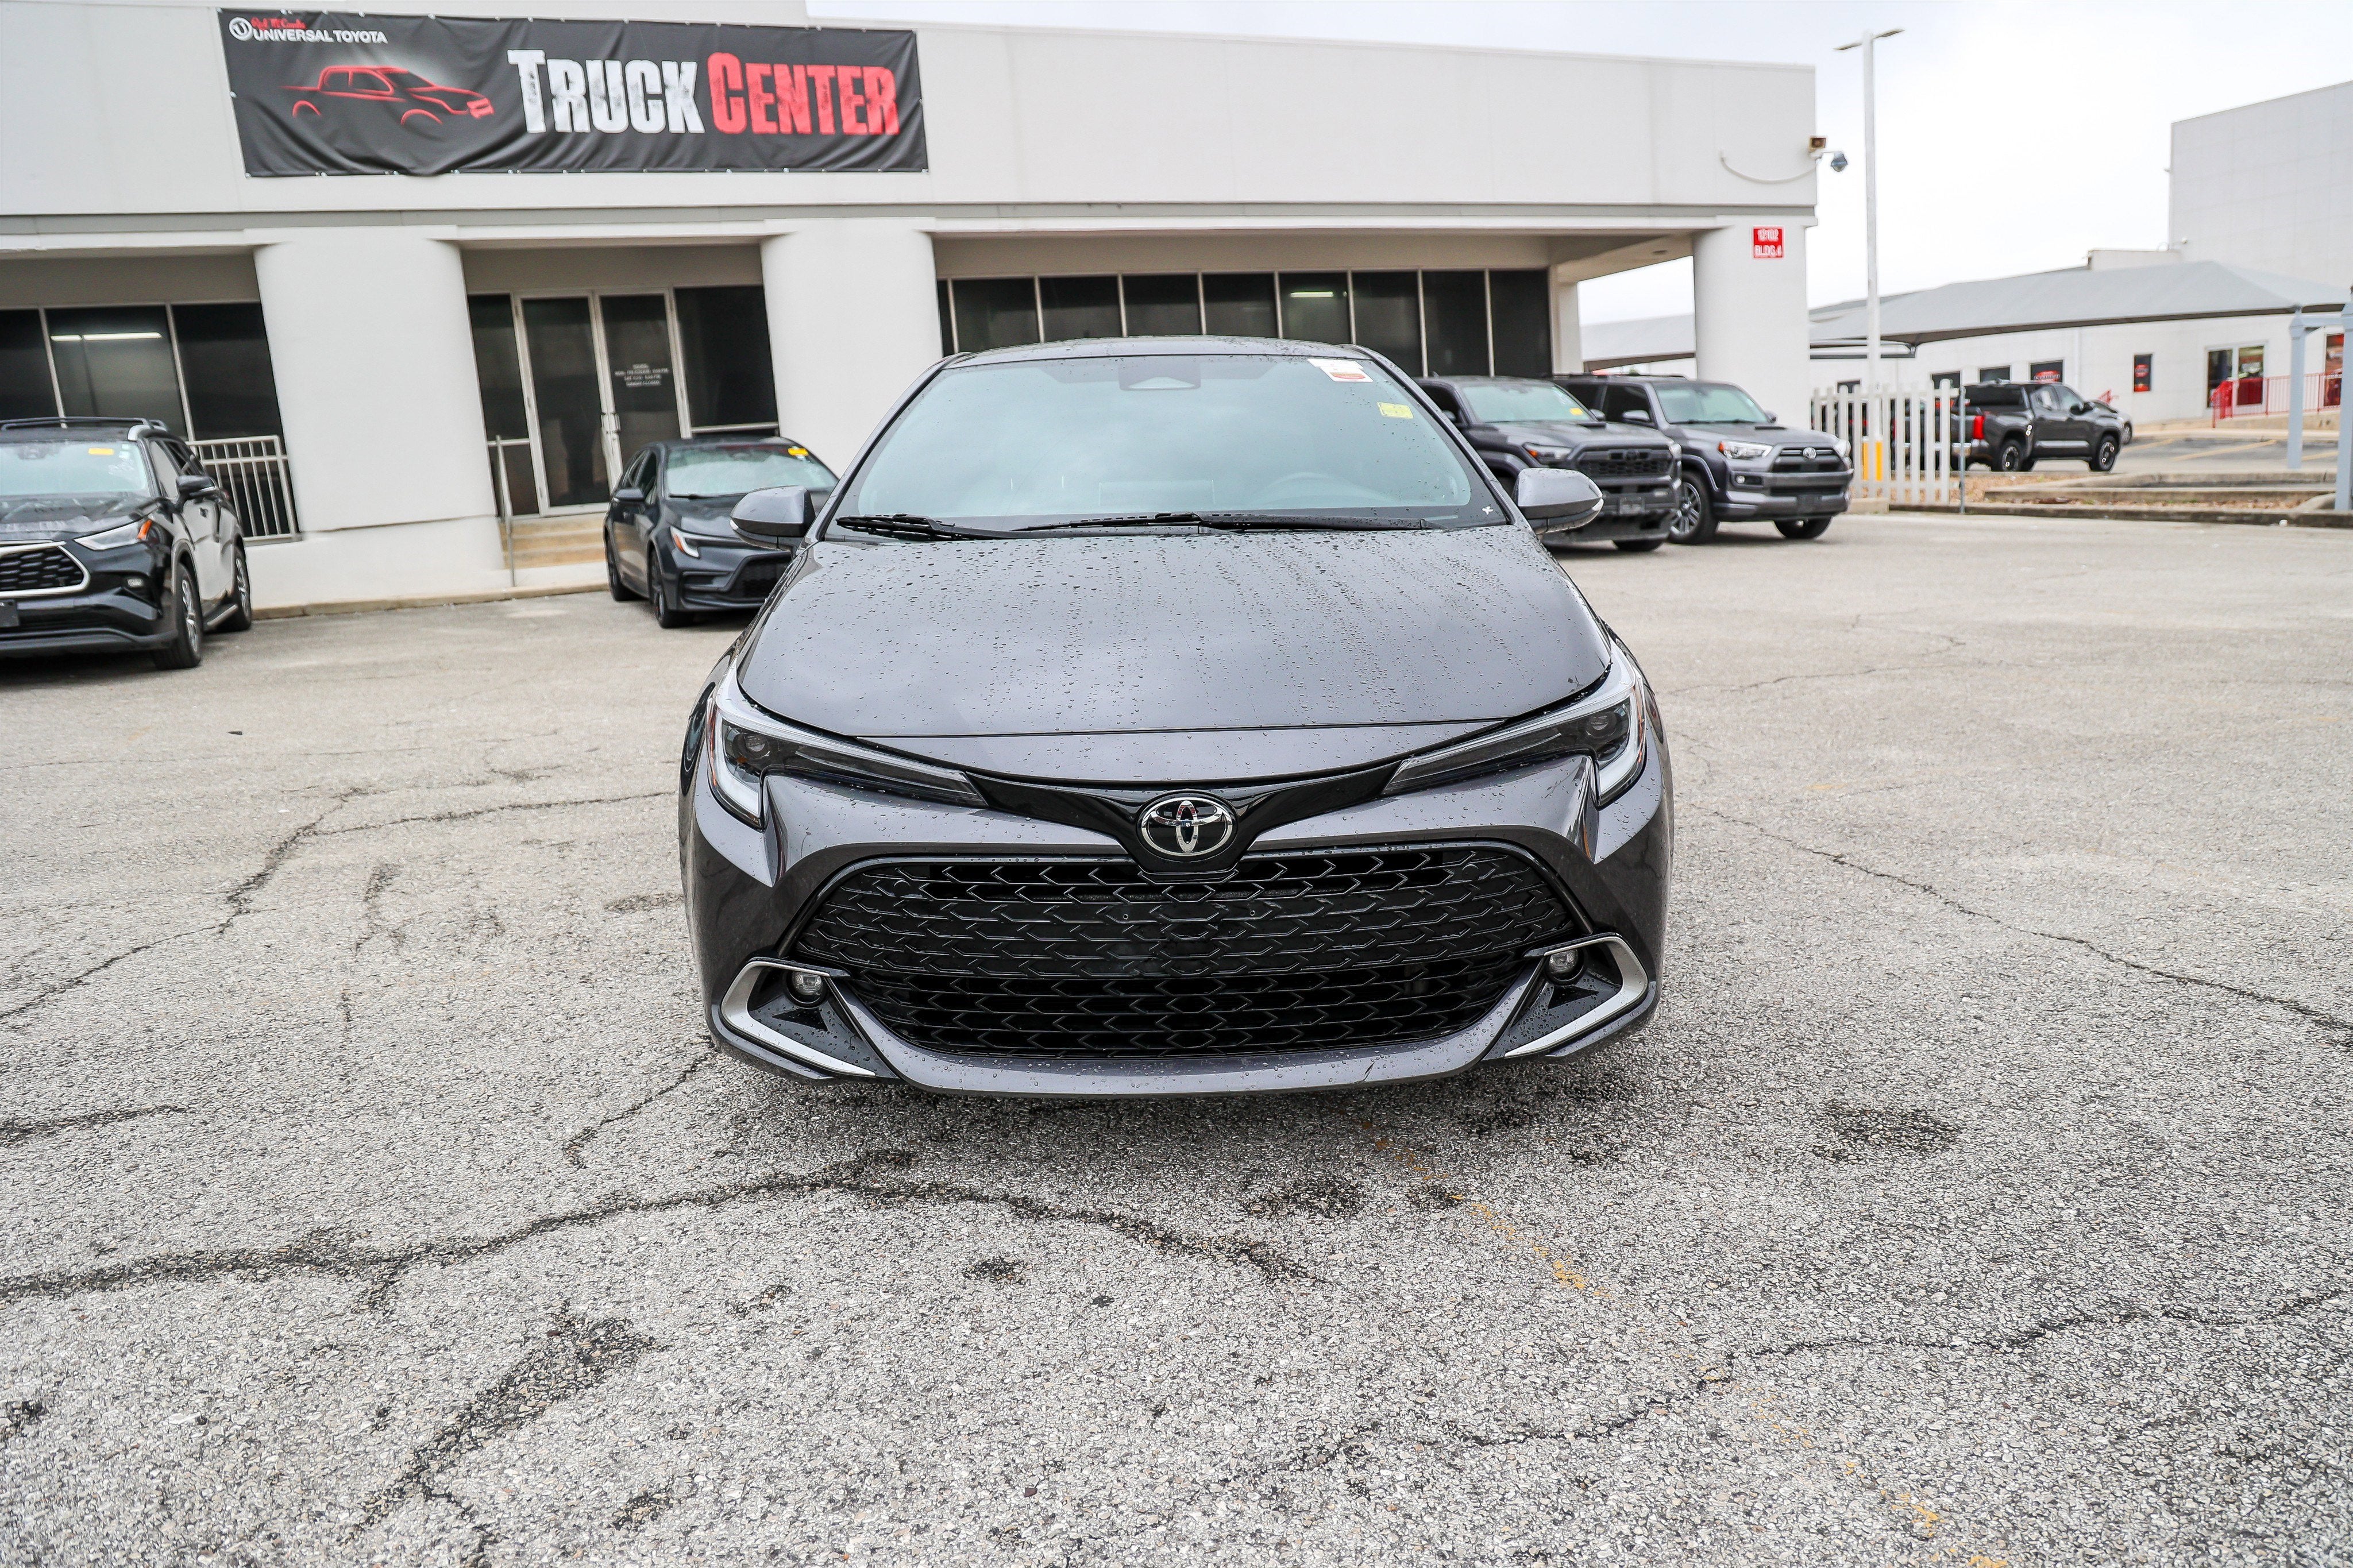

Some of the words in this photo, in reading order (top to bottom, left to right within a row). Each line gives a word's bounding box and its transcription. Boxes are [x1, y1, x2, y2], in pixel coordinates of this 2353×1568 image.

[253, 28, 334, 43] UNIVERSAL
[333, 30, 388, 44] TOYOTA
[507, 49, 705, 134] TRUCK
[707, 52, 900, 136] CENTER
